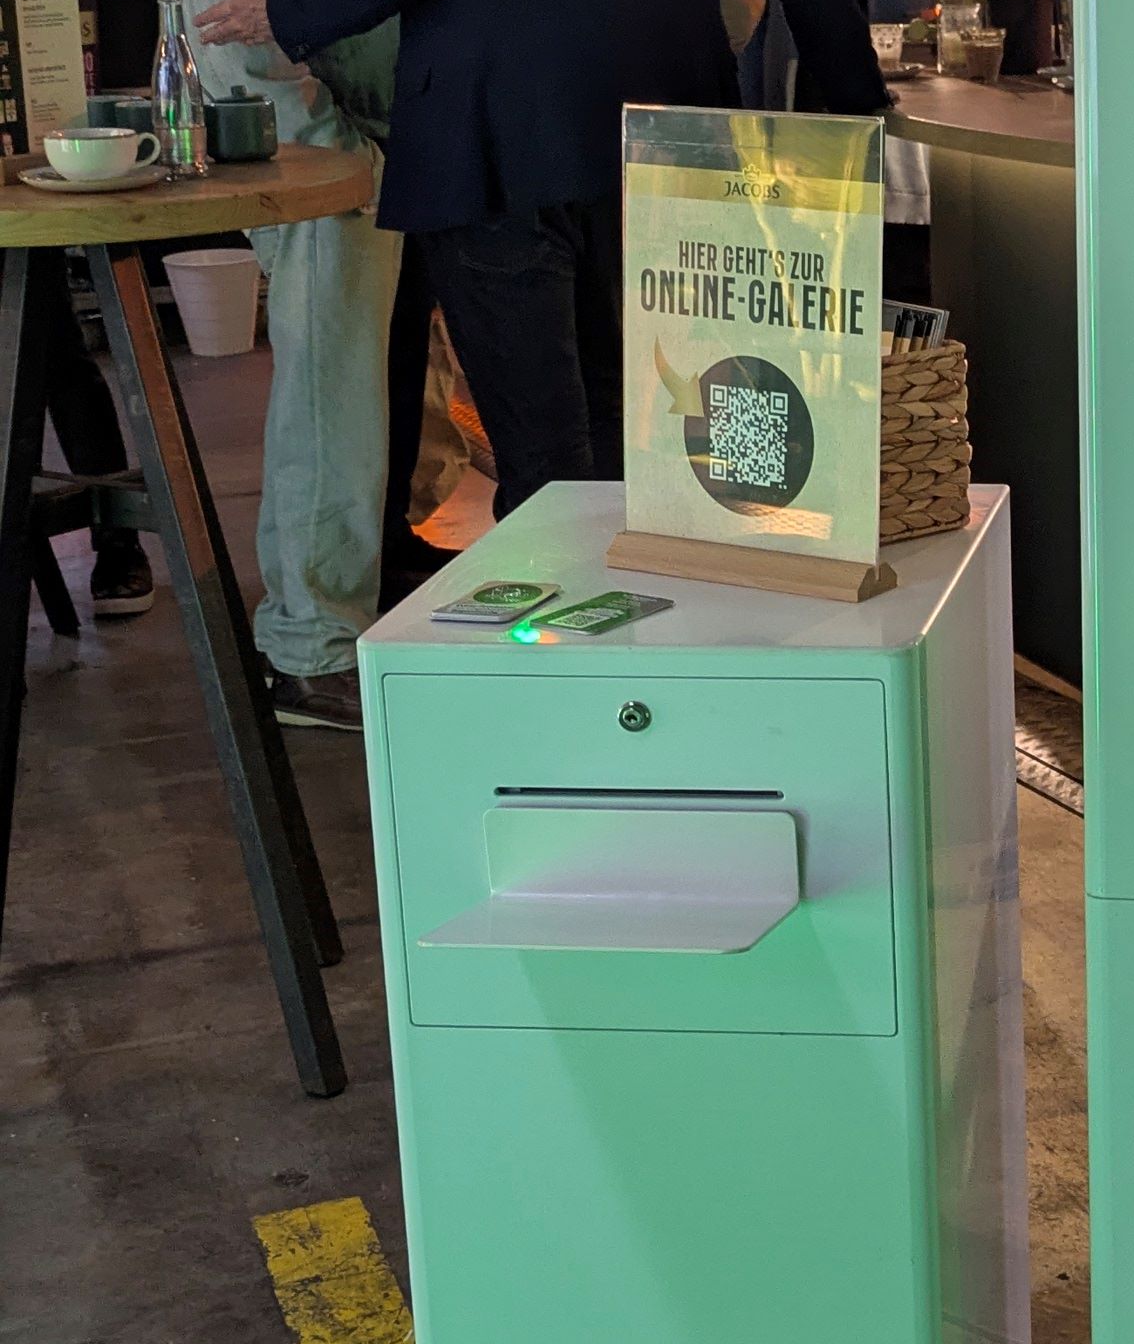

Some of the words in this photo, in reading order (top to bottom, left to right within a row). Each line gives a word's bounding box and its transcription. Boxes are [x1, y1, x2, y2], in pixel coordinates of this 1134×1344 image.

[723, 181, 780, 199] JACOBS
[678, 240, 717, 272] HIER
[723, 245, 785, 278] GEHT'S
[790, 251, 824, 282] ZUR
[640, 268, 865, 335] ONLINE-GALERIE
